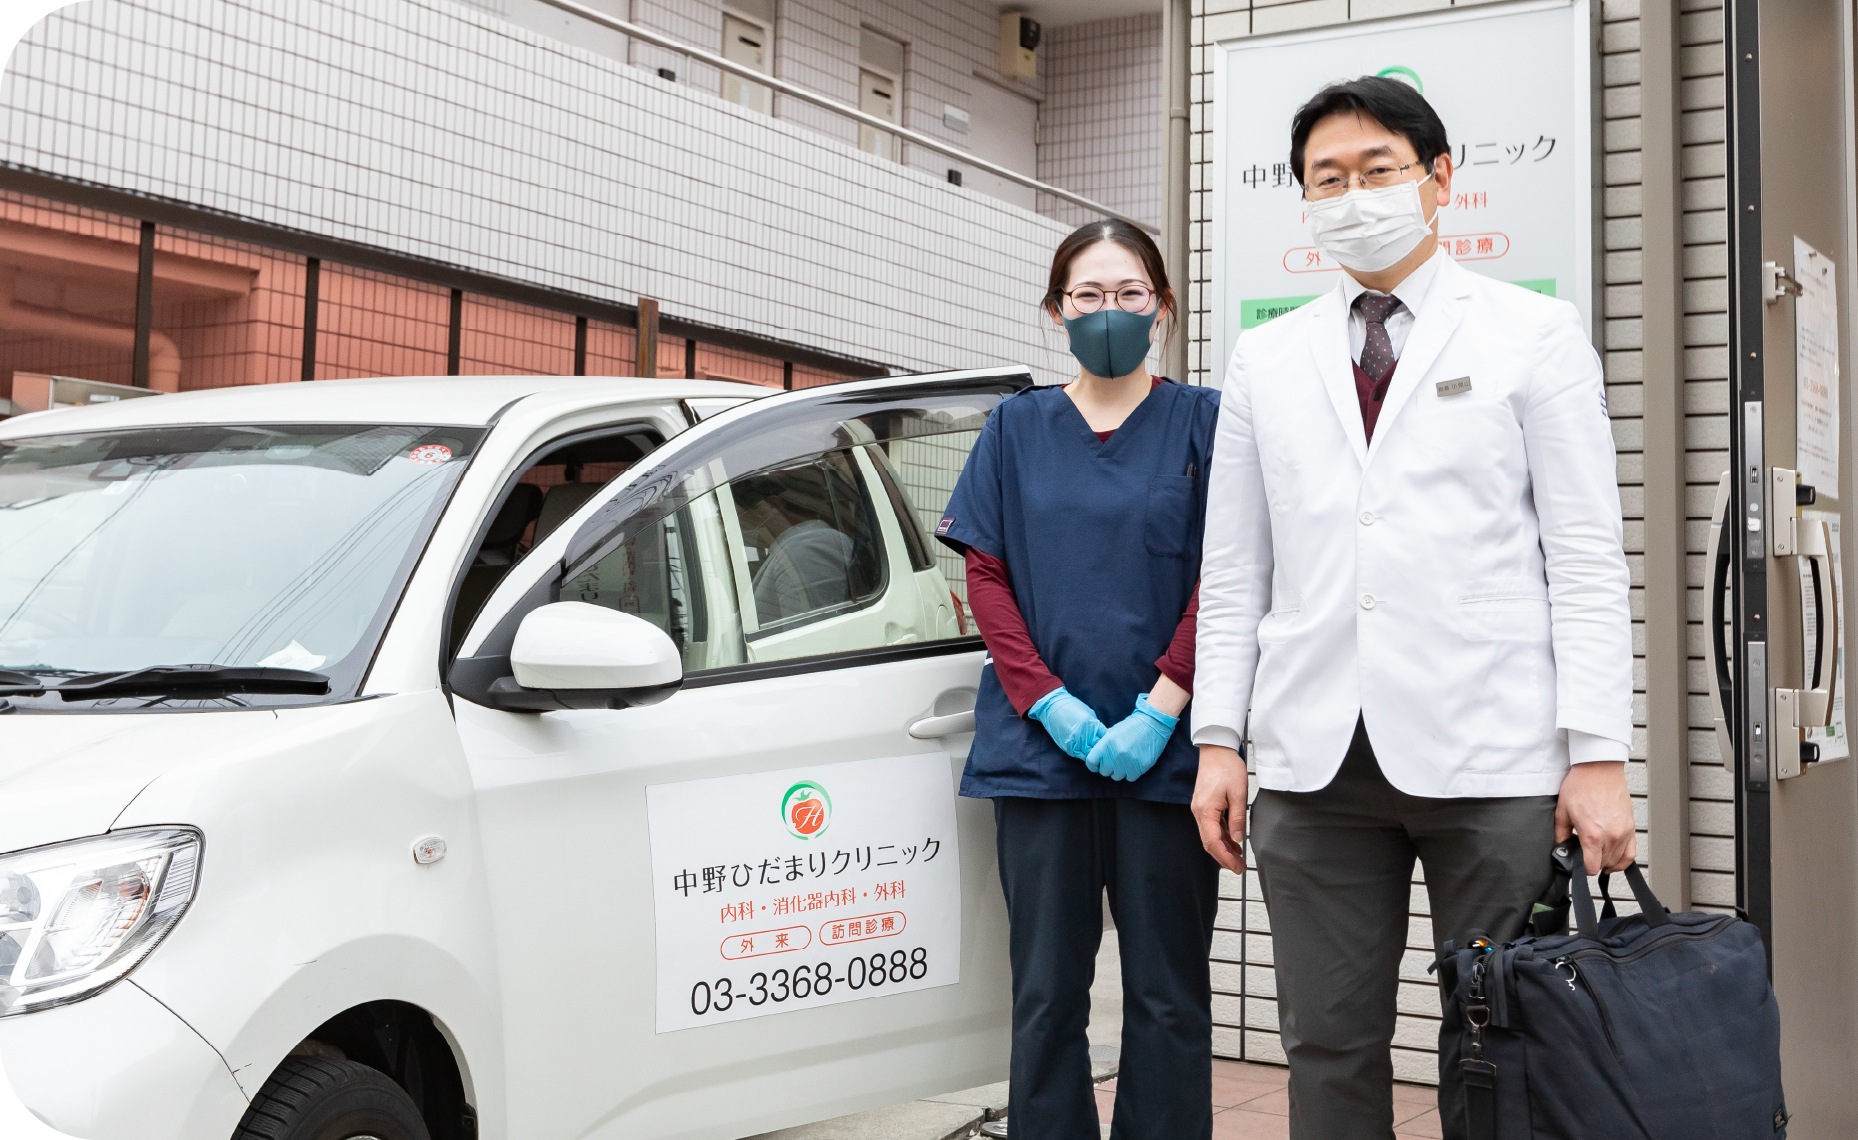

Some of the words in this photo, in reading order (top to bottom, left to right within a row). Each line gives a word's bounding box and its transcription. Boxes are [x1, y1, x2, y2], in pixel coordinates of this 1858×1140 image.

[1454, 191, 1488, 211] 外科
[673, 837, 942, 897] 中野ひだまりクリニック
[720, 880, 907, 924] 内科・消化器内科・外科
[831, 916, 895, 940] 訪問診療
[690, 946, 928, 1016] 03-3368-0888
